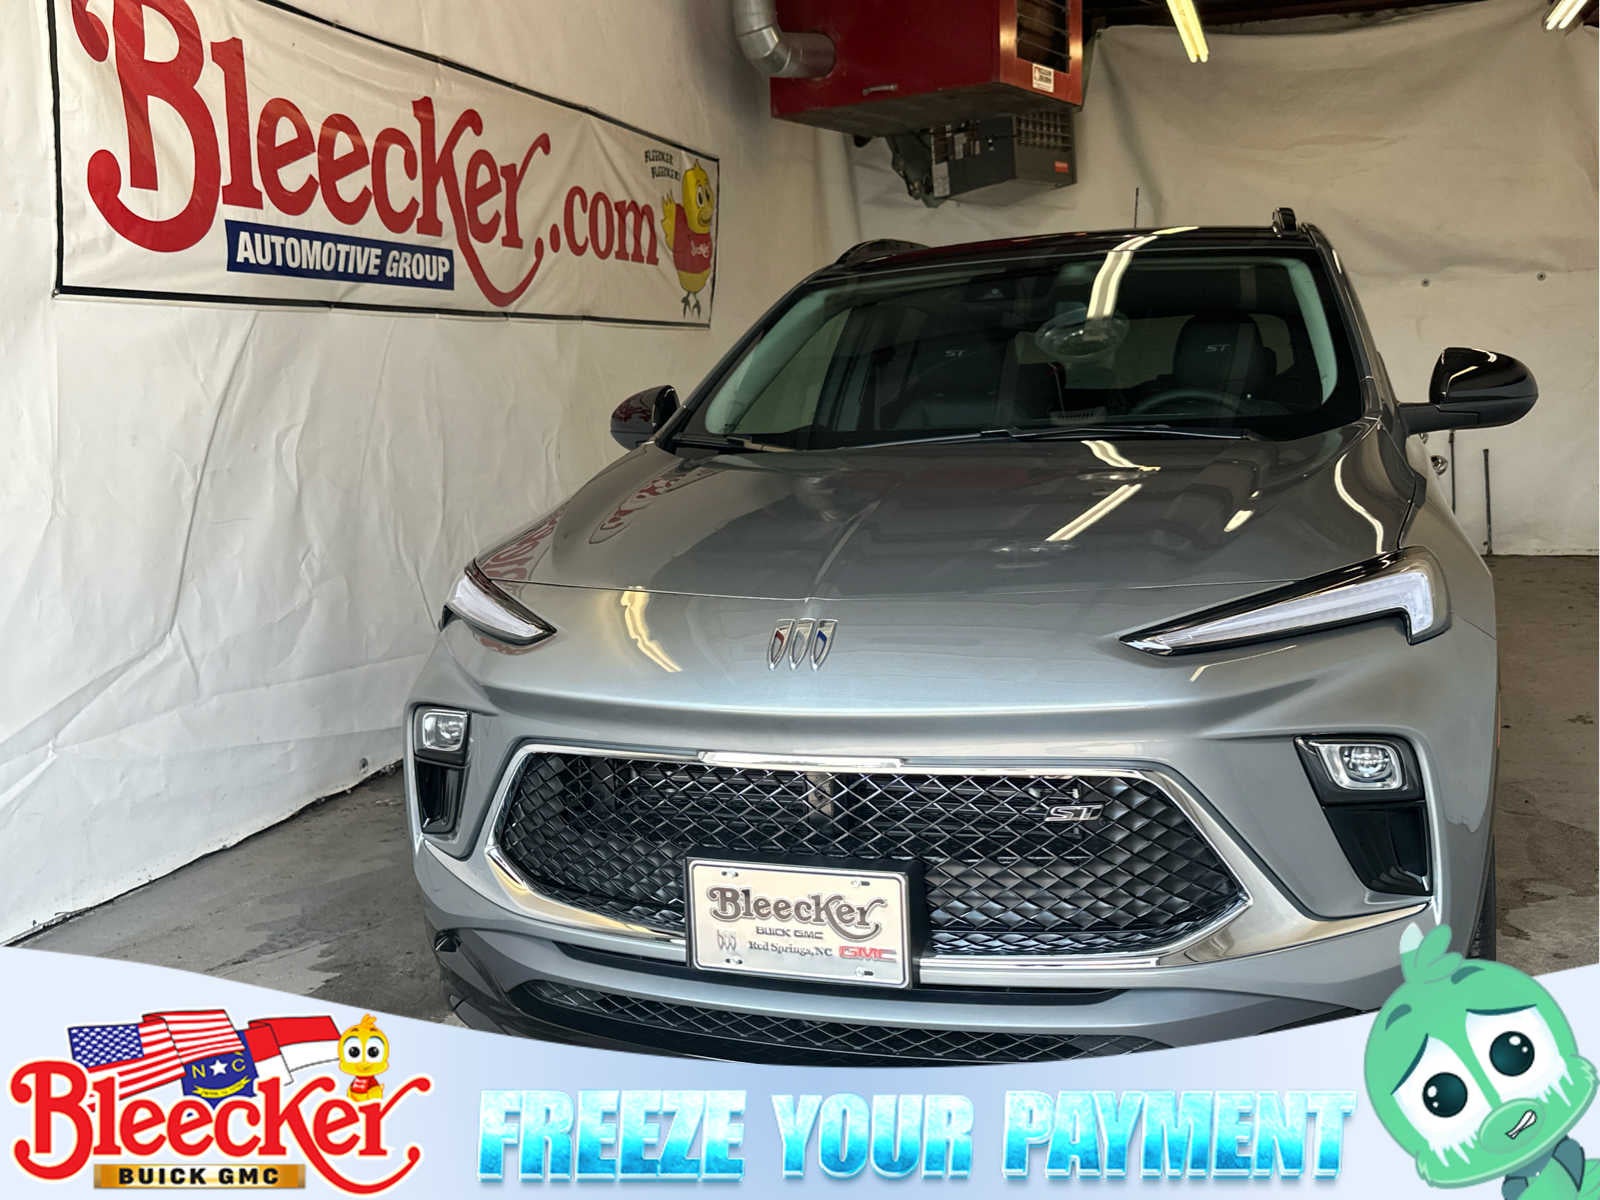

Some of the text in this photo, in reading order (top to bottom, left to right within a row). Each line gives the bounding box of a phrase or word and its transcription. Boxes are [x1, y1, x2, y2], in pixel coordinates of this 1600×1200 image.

[236, 230, 451, 283] AUTOMOTIVE GROUP
[1204, 343, 1231, 353] ST
[1044, 804, 1104, 822] ST
[706, 886, 888, 943] Bleecker
[756, 926, 824, 940] BUICK GMC
[748, 940, 770, 953] Red
[815, 945, 833, 957] NC
[838, 945, 897, 964] GMC
